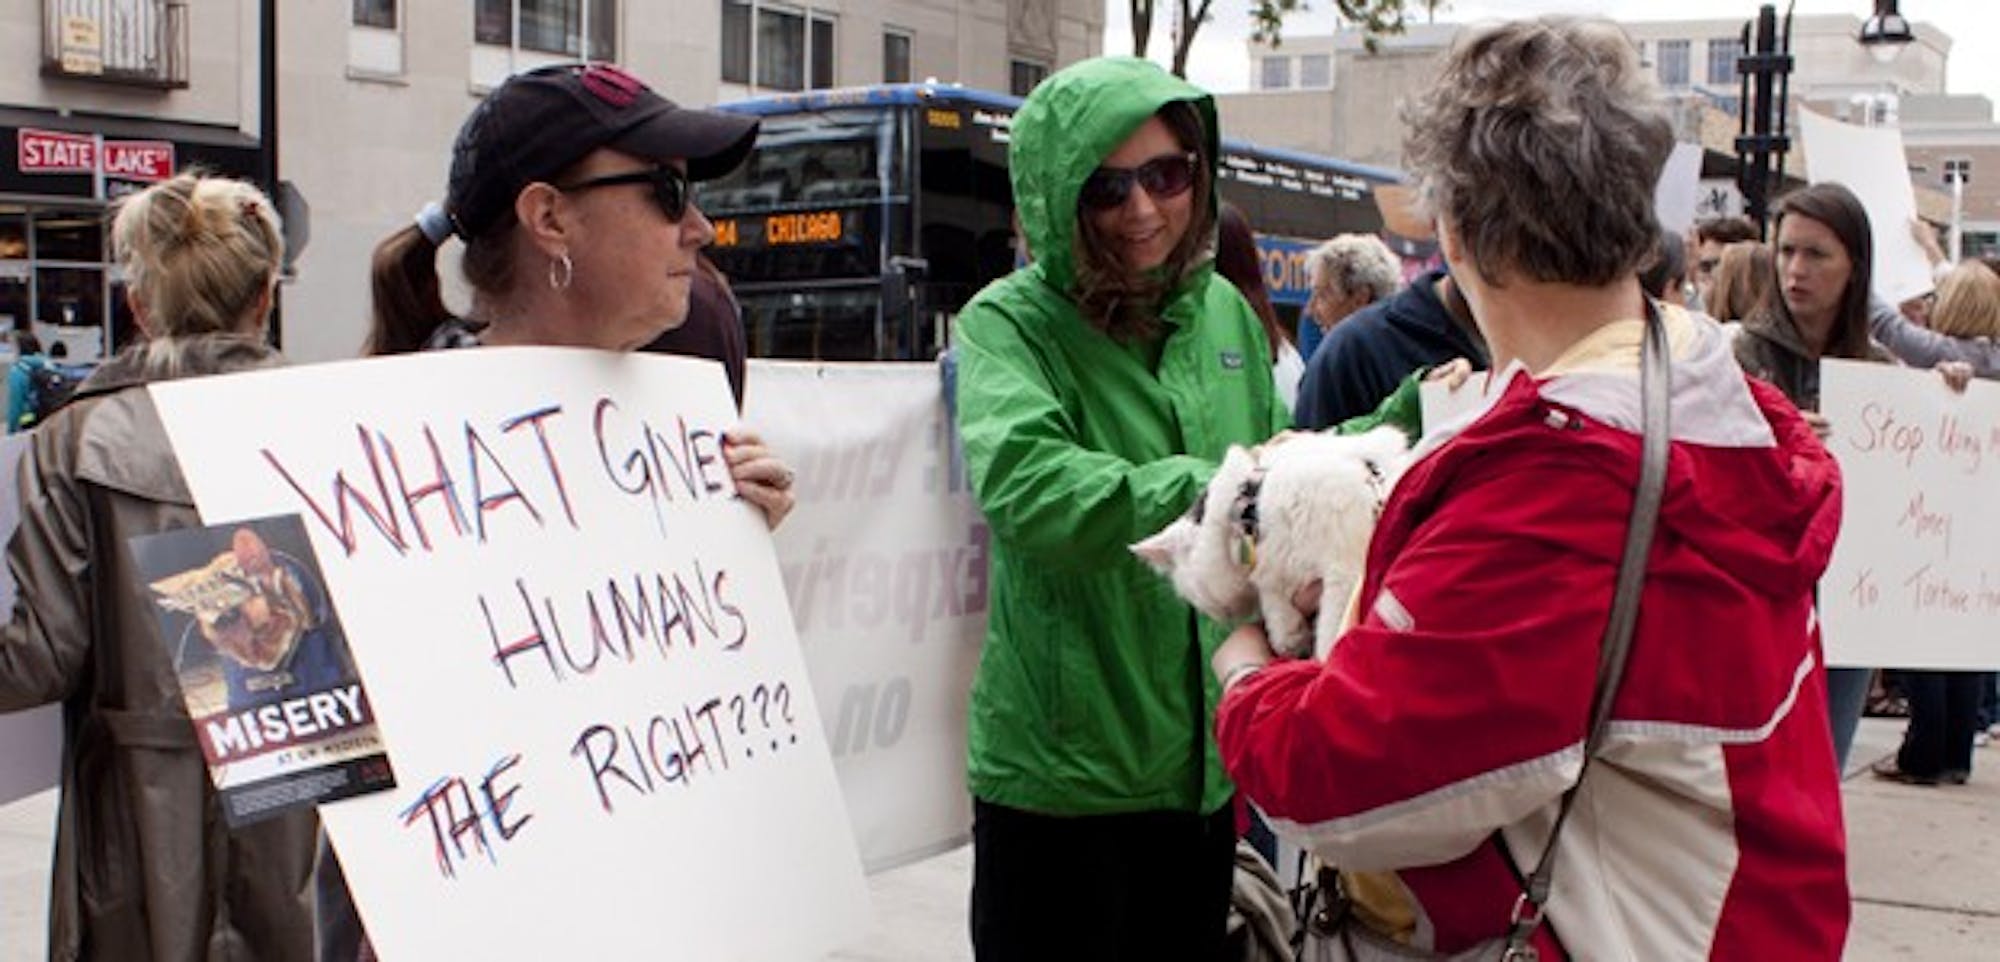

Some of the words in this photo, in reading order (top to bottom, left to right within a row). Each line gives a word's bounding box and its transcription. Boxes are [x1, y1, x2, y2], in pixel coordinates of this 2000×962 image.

[24, 138, 92, 168] STATE
[104, 148, 157, 175] LAKE
[767, 211, 842, 243] CHICAGO
[1849, 401, 1924, 468] Stop
[260, 404, 579, 558] WHAT
[478, 560, 749, 688] HUMANS
[206, 685, 366, 759] MISERY
[398, 754, 533, 879] THE
[570, 682, 798, 813] RIGHT???
